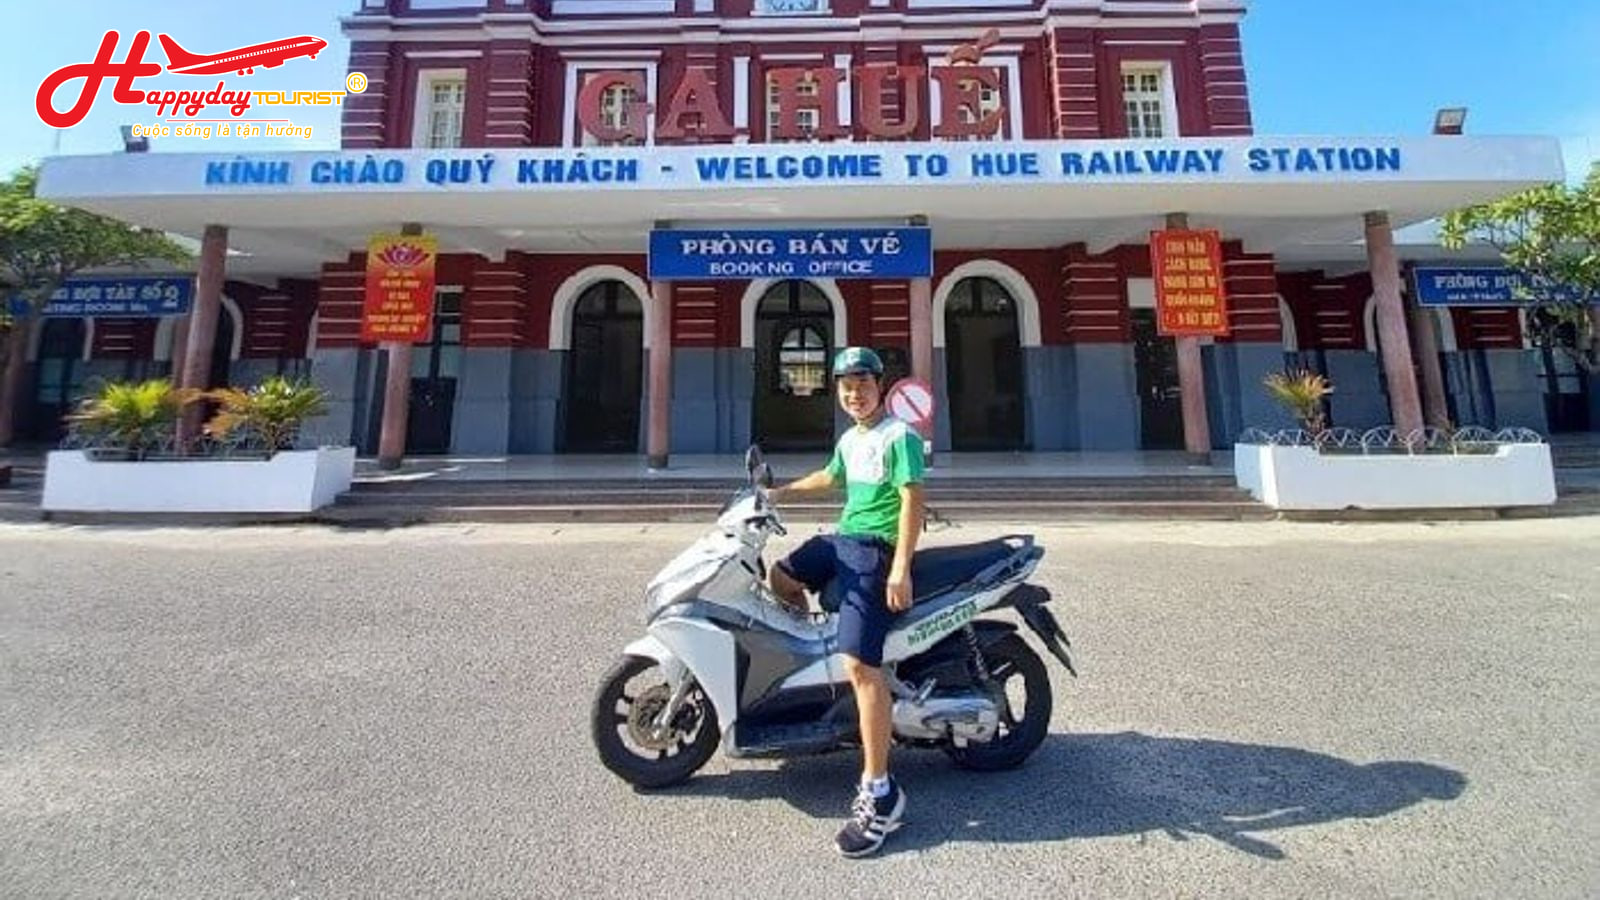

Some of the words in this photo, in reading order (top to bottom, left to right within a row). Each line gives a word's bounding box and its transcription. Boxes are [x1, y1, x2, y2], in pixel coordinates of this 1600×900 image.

[578, 67, 747, 142] GA
[205, 156, 291, 185] KÍNH
[310, 154, 404, 184] CHÀO
[425, 152, 496, 187] QUÝ
[516, 151, 639, 183] KHÁCH
[696, 154, 881, 181] WELCOME
[905, 153, 949, 177] TO
[970, 152, 1039, 176] HUE
[1061, 148, 1224, 175] RAILWAY
[1248, 146, 1401, 172] STATION
[680, 232, 777, 255] PHÒNG
[788, 231, 848, 254] BÁN
[860, 230, 901, 255] VÉ
[710, 261, 795, 275] BOOKNG
